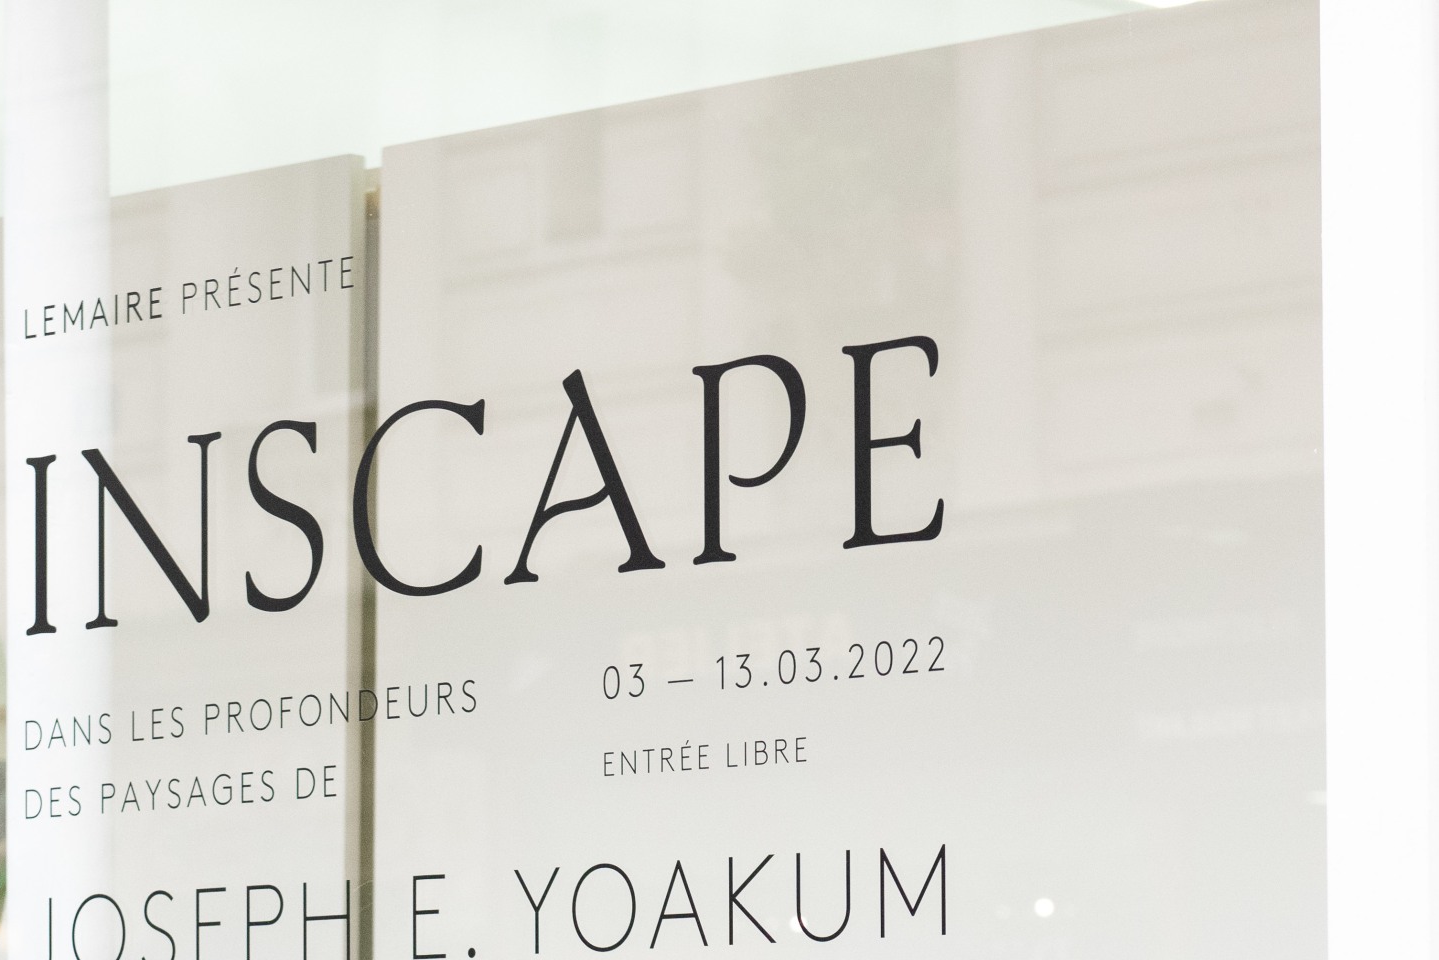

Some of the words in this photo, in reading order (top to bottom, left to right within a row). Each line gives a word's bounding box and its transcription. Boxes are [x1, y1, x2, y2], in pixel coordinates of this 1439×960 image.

[24, 286, 163, 340] LEMAIRE
[182, 255, 356, 315] PRÉSENTE
[26, 334, 945, 636] INSCAPE
[602, 663, 645, 700] 03
[715, 635, 945, 690] 13.03.2022
[24, 712, 112, 751] DANS
[131, 706, 185, 742] LES
[204, 679, 478, 734] PROFONDEURS
[25, 785, 82, 820] DES
[101, 769, 275, 815] PAYSAGES
[296, 764, 337, 800] DE
[603, 744, 710, 777] ENTRÉE
[726, 736, 808, 768] LIBRE
[412, 873, 477, 960] E.
[513, 843, 947, 955] YOAKUM
